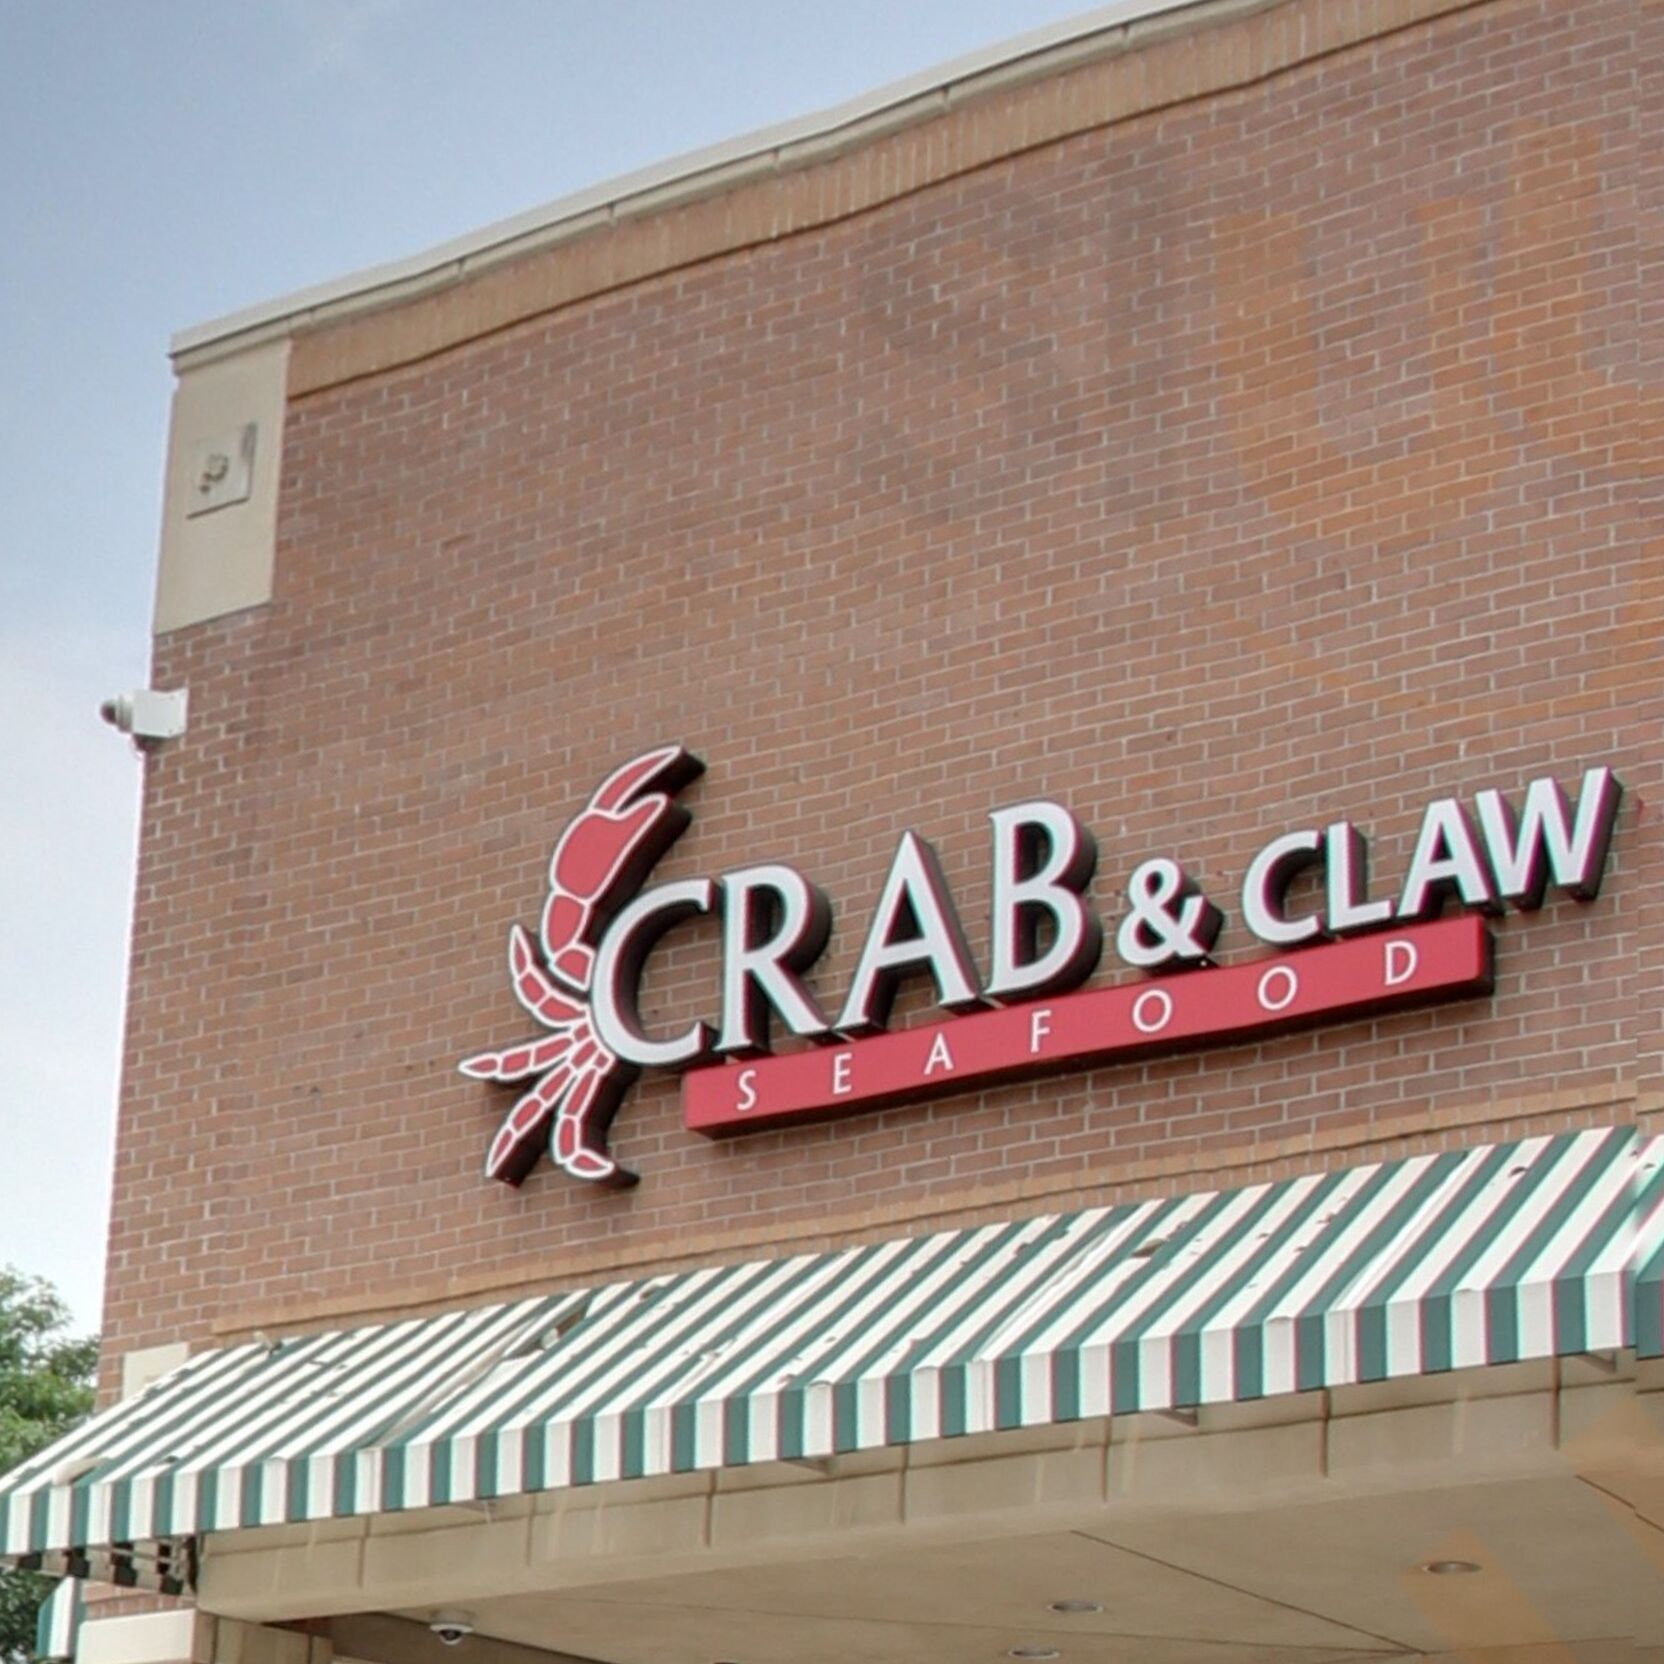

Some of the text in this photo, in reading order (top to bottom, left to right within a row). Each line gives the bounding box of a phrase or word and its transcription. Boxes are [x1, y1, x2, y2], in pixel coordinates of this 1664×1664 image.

[590, 766, 1614, 1066] CRAB & CLAW
[736, 938, 1418, 1112] SEAFOOD
